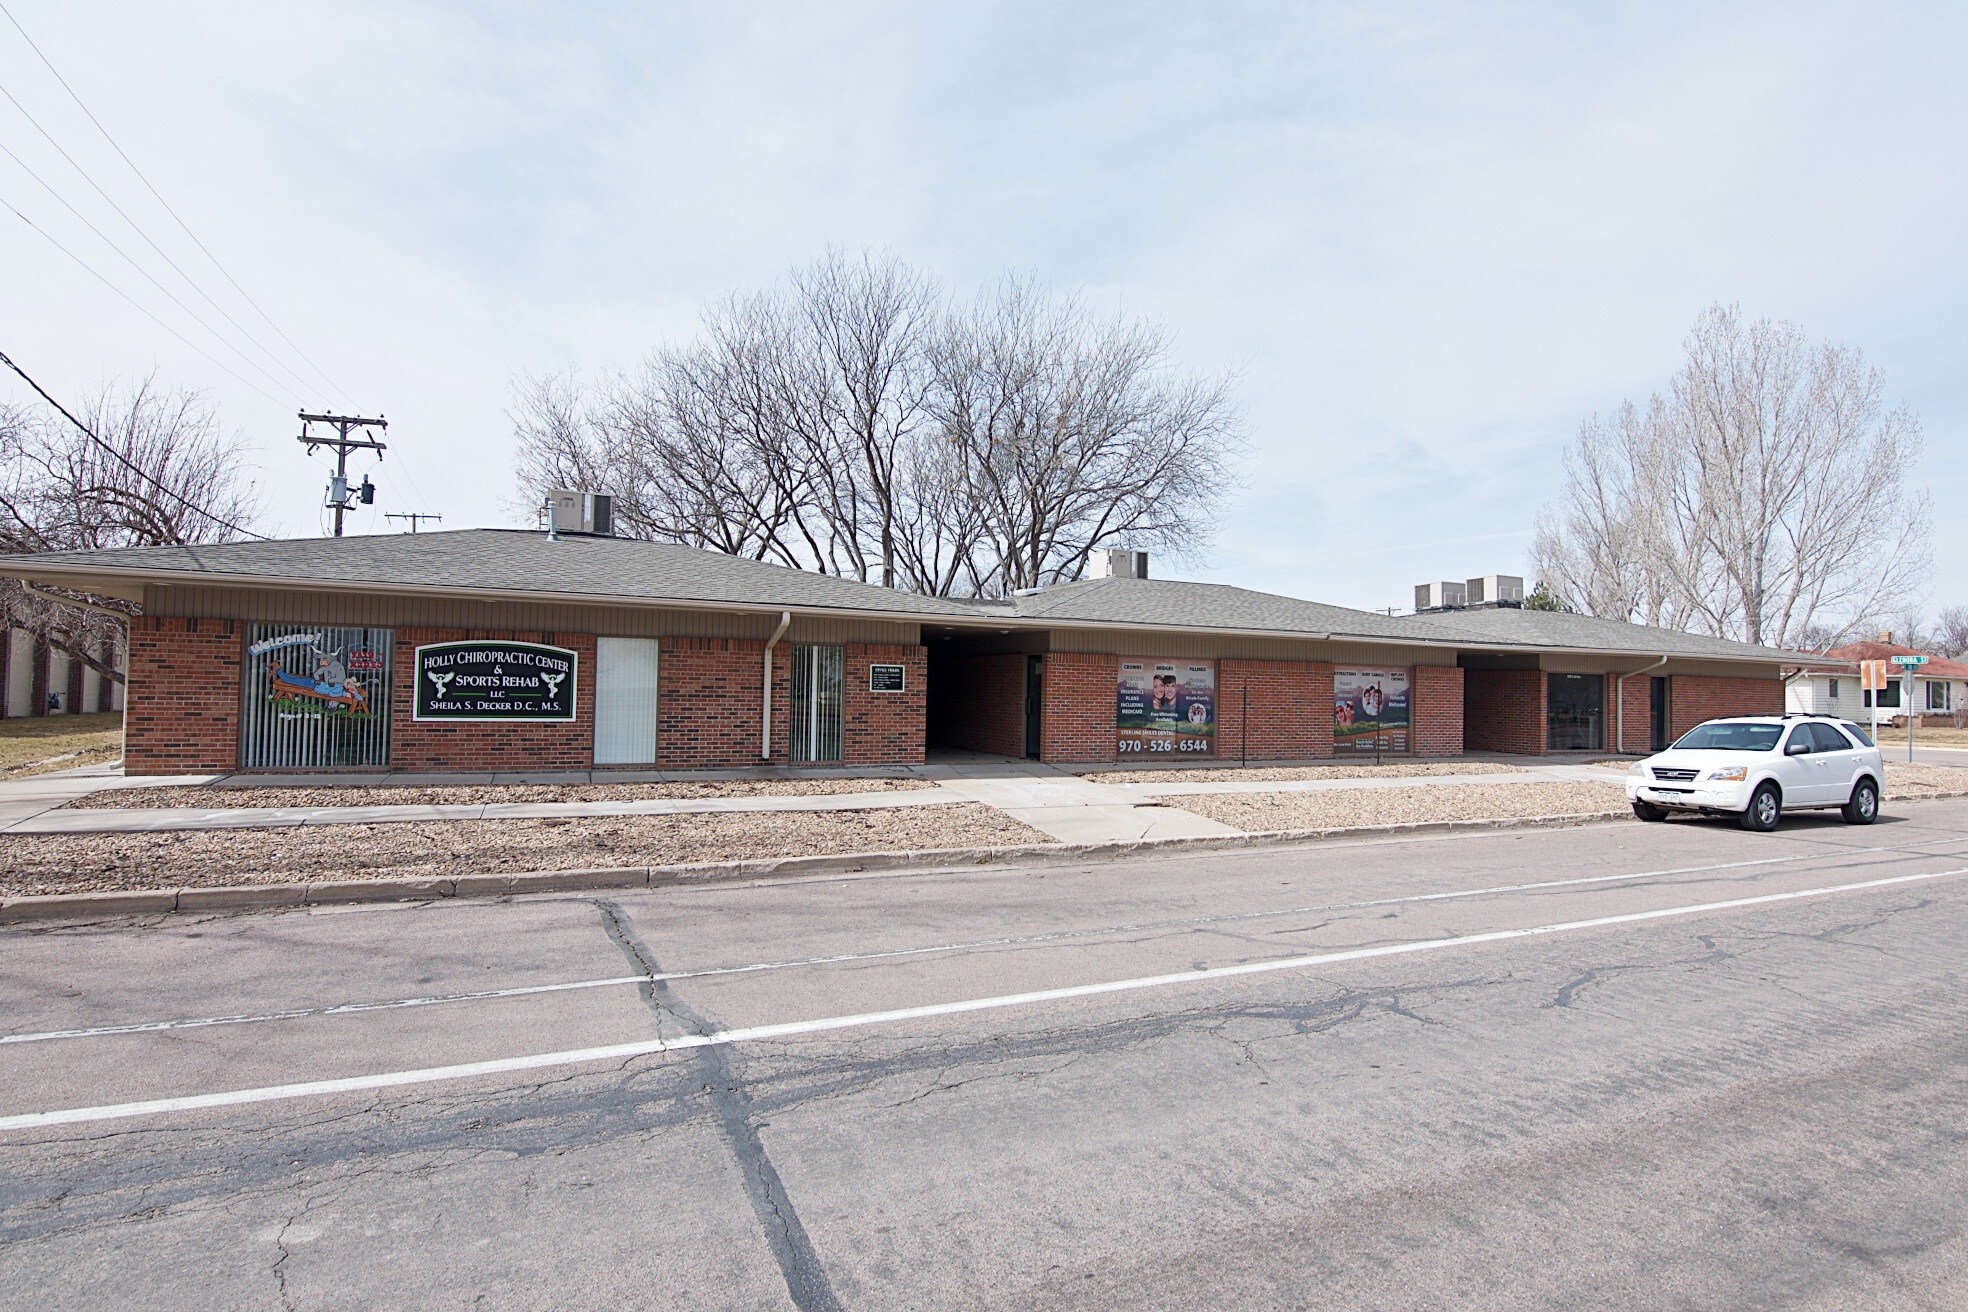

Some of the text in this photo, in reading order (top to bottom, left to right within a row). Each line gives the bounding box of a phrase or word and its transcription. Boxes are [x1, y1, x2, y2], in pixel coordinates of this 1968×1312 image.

[249, 633, 322, 655] Welcome!
[424, 651, 569, 673] HOLLY CHIROPRACTIC CENTER
[494, 665, 503, 675] &
[455, 675, 539, 687] SPORTS REHAB
[429, 701, 562, 711] SHEILA S. DECKER D.C., M.S.
[1119, 740, 1141, 752] 970
[1150, 740, 1172, 751] 526
[1180, 740, 1207, 751] 6544
